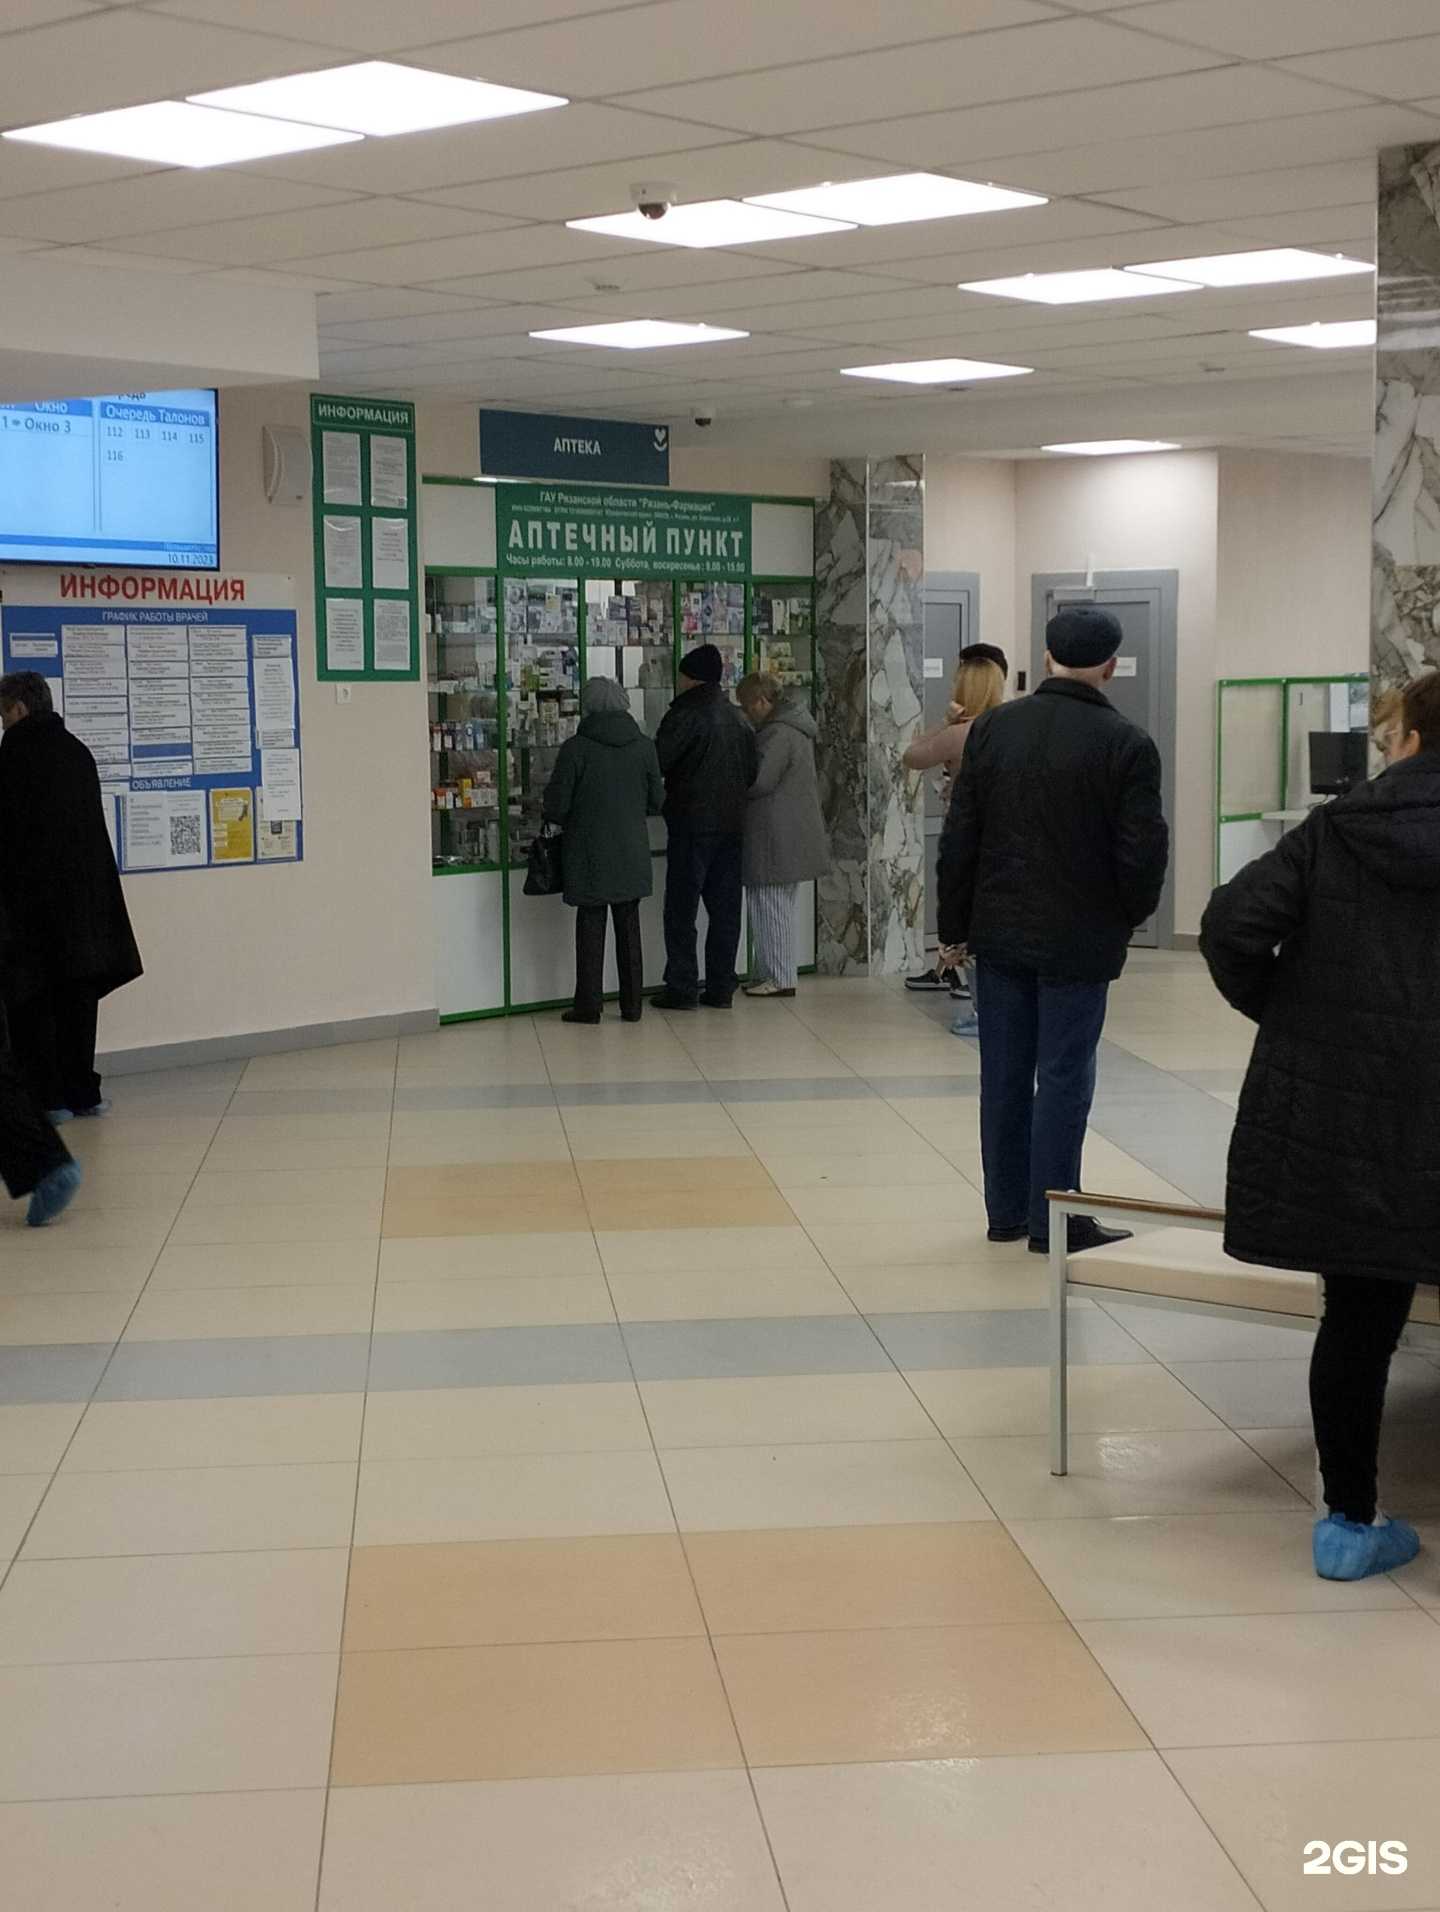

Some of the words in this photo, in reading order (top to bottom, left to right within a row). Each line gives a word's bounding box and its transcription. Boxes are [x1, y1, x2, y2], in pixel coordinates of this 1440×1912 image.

[105, 404, 157, 423] Очередь
[158, 409, 206, 426] Талонов
[318, 403, 410, 425] ИНФОРМАЦИЯ
[24, 417, 60, 433] Окно
[64, 420, 72, 433] 3
[106, 426, 124, 438] 112
[162, 430, 178, 442] 114
[189, 432, 205, 444] 115
[553, 437, 602, 456] АПТЕКА
[107, 450, 124, 462] 116
[539, 491, 557, 503] ГАУ
[557, 492, 602, 506] Рязанской
[508, 519, 657, 555] АПТЕЧНЫЙ
[666, 527, 744, 558] ПУНКТ
[505, 552, 530, 565] Часы
[531, 554, 565, 568] работы:
[615, 557, 650, 571] Суббота,
[60, 574, 246, 606] ИНФОРМАЦИЯ
[101, 610, 138, 622] ГРАФИК
[139, 610, 174, 622] РАБОТЫ
[175, 610, 209, 623] ВРАЧЕЙ
[131, 777, 192, 790] ОБЪЯВЛЕНИЕ
